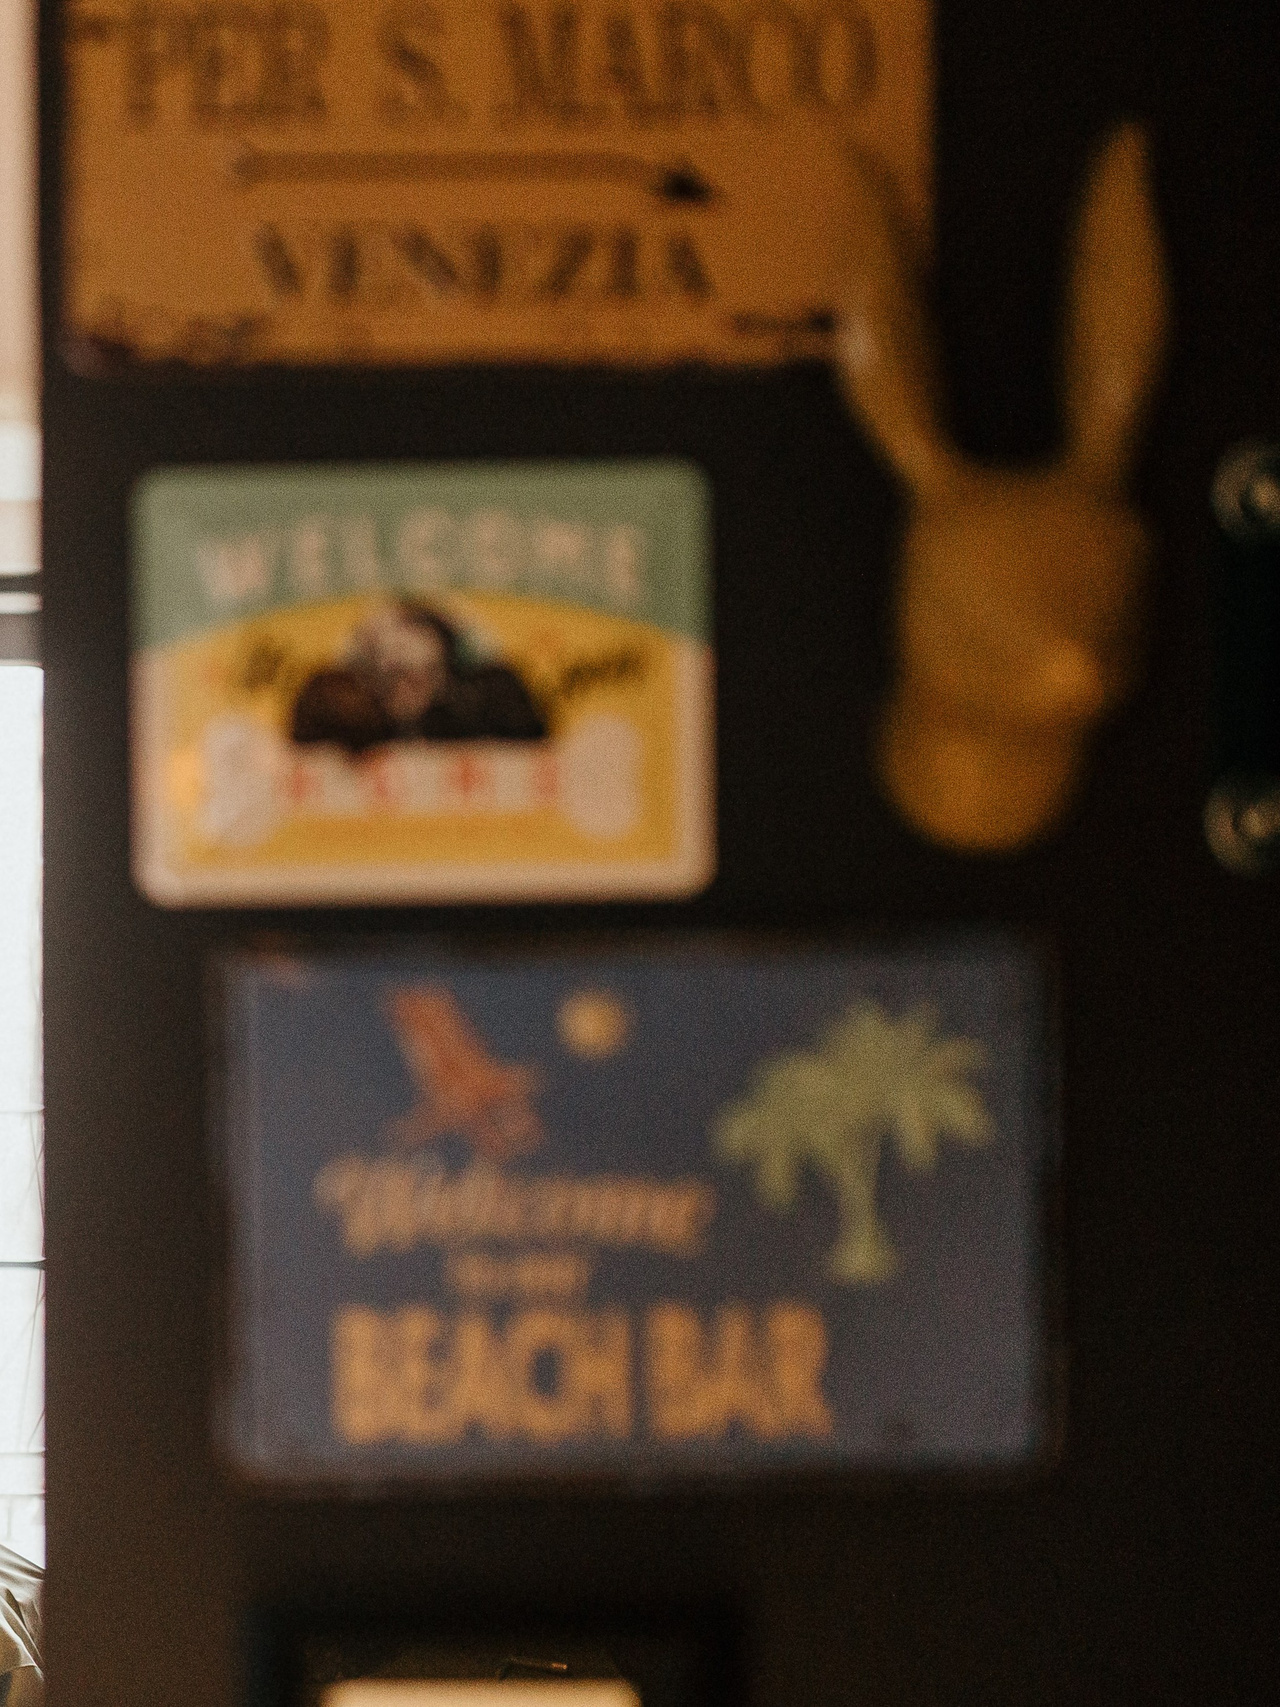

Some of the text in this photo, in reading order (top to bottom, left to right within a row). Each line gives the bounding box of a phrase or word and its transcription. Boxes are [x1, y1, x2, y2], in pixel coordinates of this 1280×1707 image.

[123, 3, 326, 127] PER
[498, 0, 880, 125] MARCO
[253, 222, 715, 306] VENEZIA
[197, 510, 643, 602] WELCOME
[336, 1305, 830, 1442] BEACH BAR
